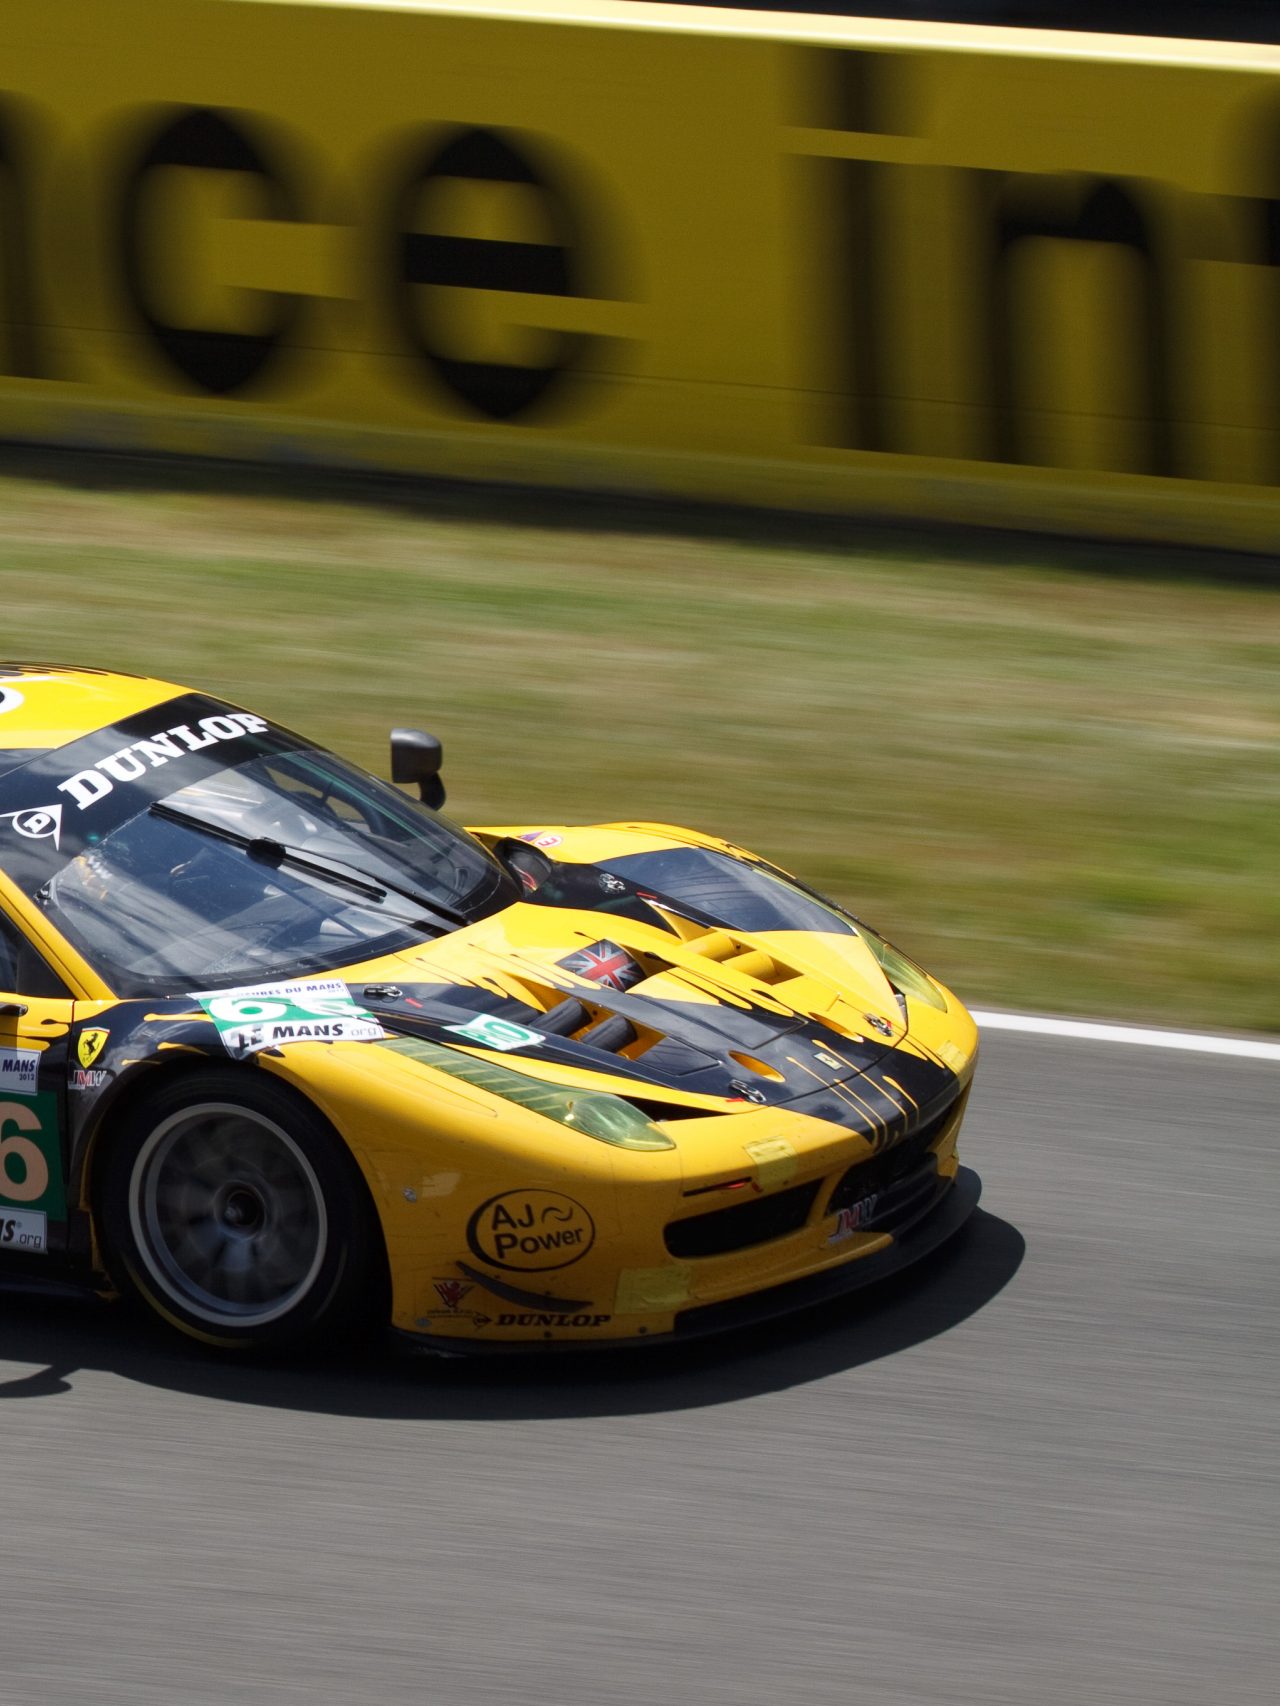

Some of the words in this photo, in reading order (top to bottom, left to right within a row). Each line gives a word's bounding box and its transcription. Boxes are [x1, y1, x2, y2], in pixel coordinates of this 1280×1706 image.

[57, 712, 270, 810] DUNLOP
[307, 982, 342, 993] MANS
[273, 1023, 344, 1040] MANS
[2, 1058, 36, 1073] MANS
[491, 1203, 534, 1231] AJ
[492, 1226, 584, 1260] Power
[496, 1313, 611, 1327] DUNLOP
